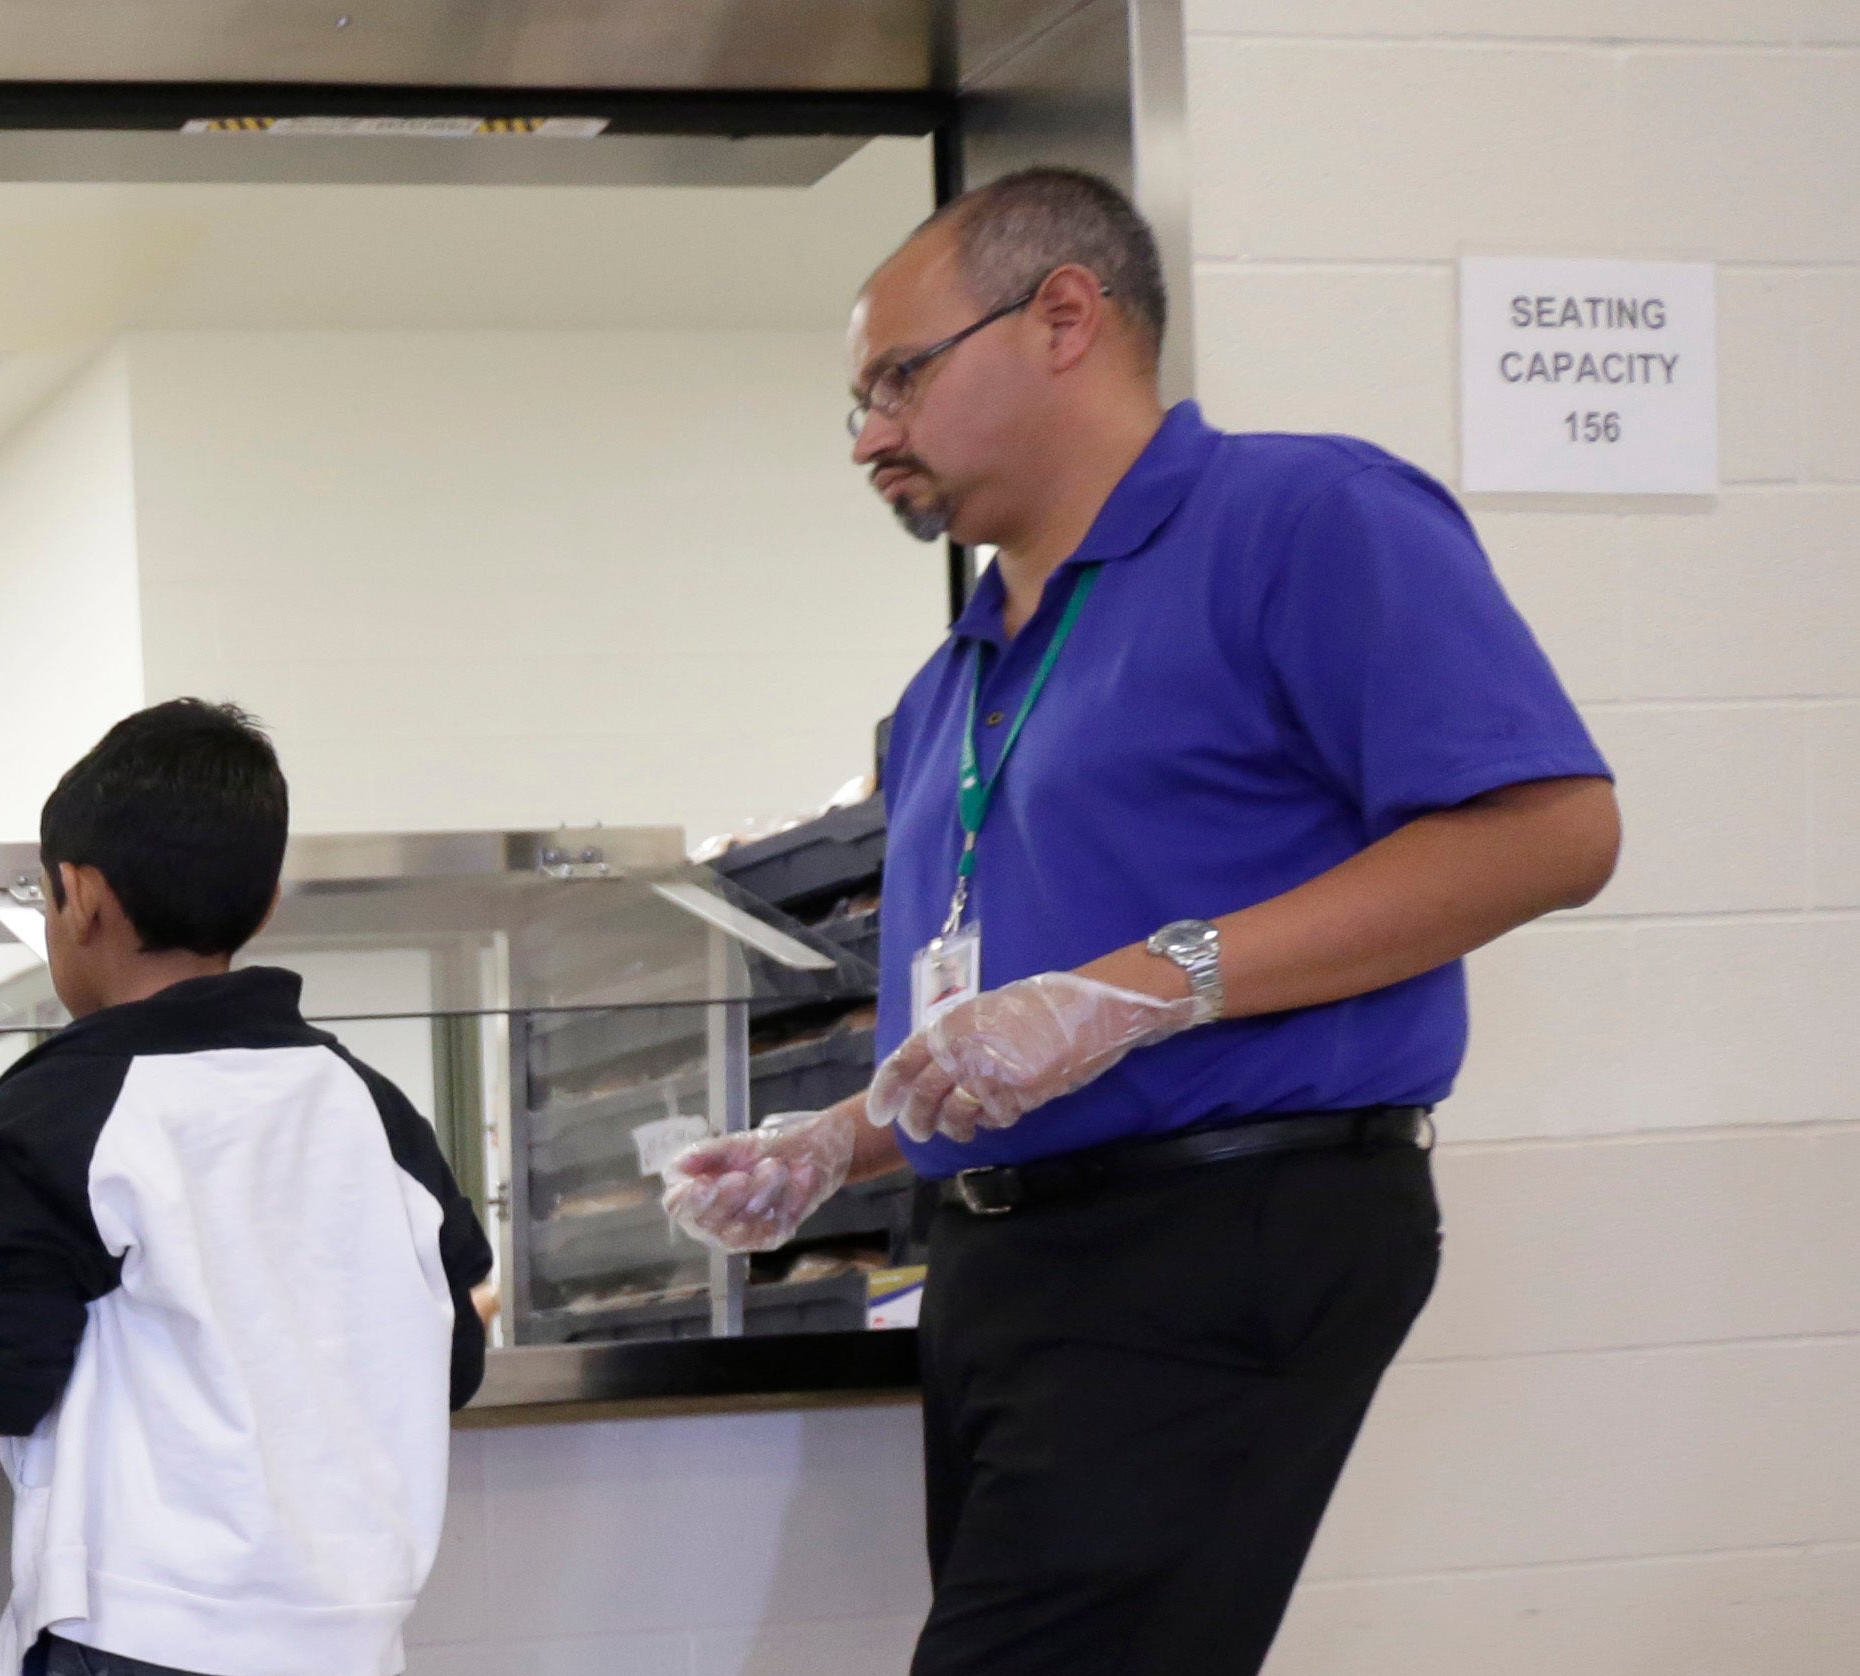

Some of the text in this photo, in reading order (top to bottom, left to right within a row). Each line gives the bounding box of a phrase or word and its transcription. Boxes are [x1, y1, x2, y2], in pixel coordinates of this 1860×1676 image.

[1510, 295, 1667, 330] SEATING
[1499, 351, 1680, 385] CAPACITY
[1564, 410, 1622, 444] 156
